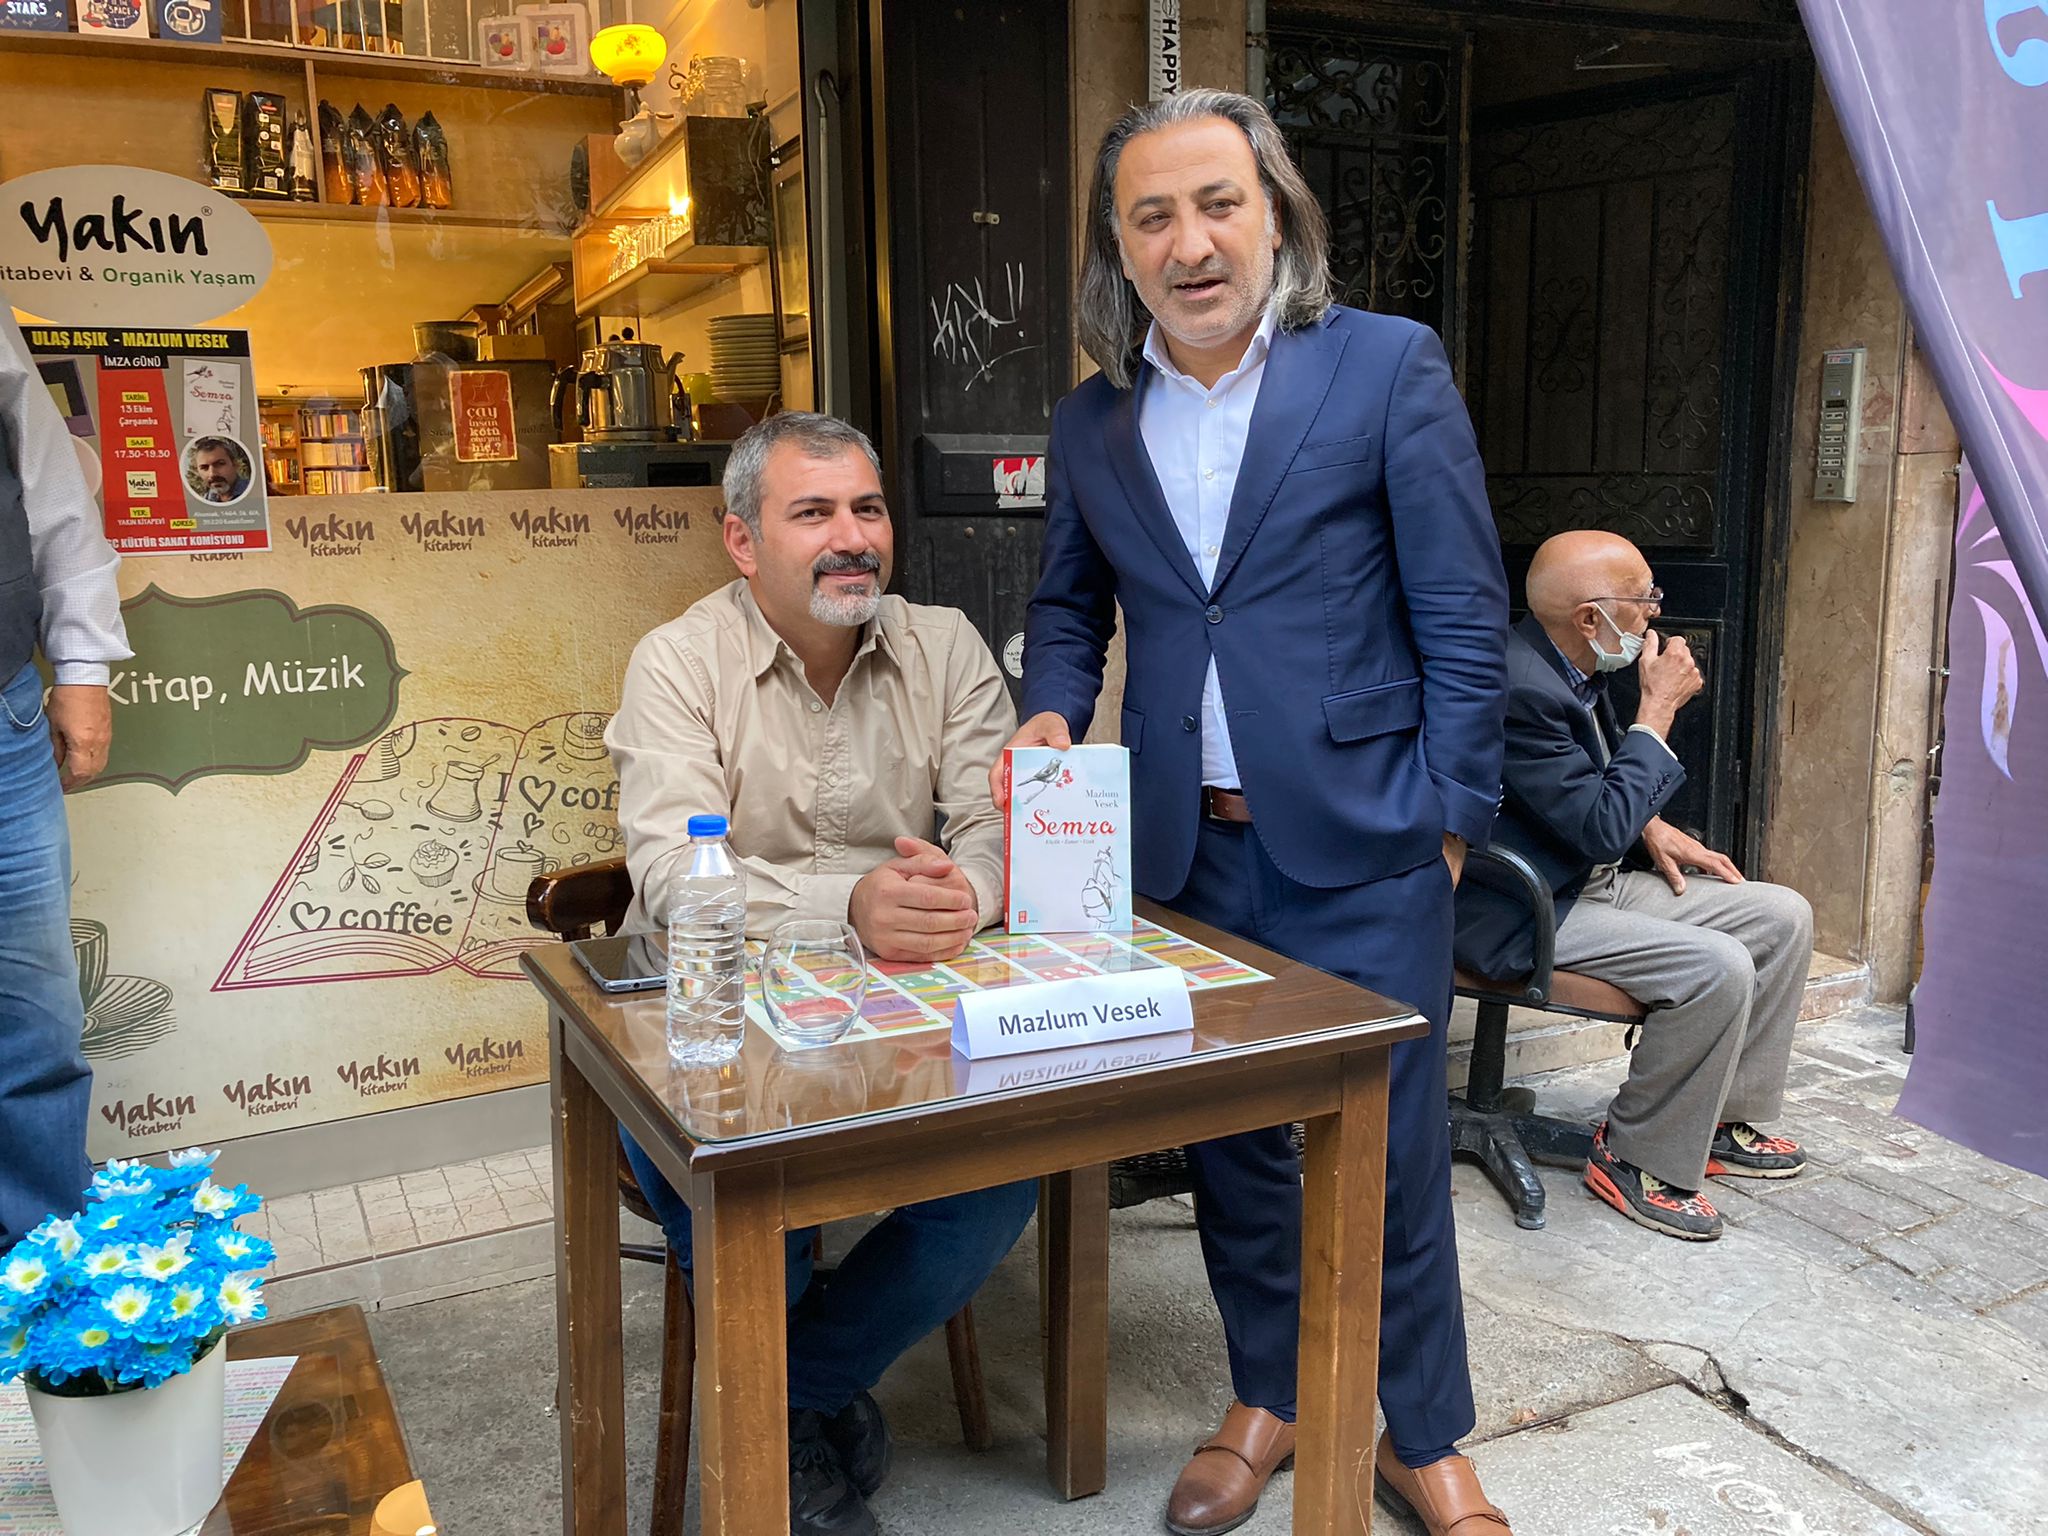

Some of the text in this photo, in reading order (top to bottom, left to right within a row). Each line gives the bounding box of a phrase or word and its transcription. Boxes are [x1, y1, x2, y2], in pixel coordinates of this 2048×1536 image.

[7, 1, 48, 16] STARS
[108, 4, 132, 16] SPACE
[1161, 18, 1177, 96] HAPPY
[78, 266, 95, 282] &
[102, 267, 186, 287] Organik
[189, 269, 256, 287] Yaşam
[31, 331, 69, 350] ULAŞ
[72, 331, 109, 350] AŞIK
[121, 331, 183, 348] MAZLUM
[184, 332, 229, 349] VESEK
[103, 354, 162, 368] İMZA GÜNÜ
[120, 404, 133, 414] 13
[466, 407, 498, 420] çay
[118, 416, 159, 428] Çarşamba
[121, 535, 157, 548] KÜLTÜR
[158, 535, 188, 547] SANAT
[189, 533, 245, 547] KOMİSYONU
[243, 654, 365, 697] Müzik
[1085, 788, 1119, 799] Mazlum
[1094, 799, 1119, 809] Vesek
[1025, 808, 1117, 836] Semra
[339, 900, 453, 936] coffee
[998, 996, 1162, 1037] Mazlum Vesek
